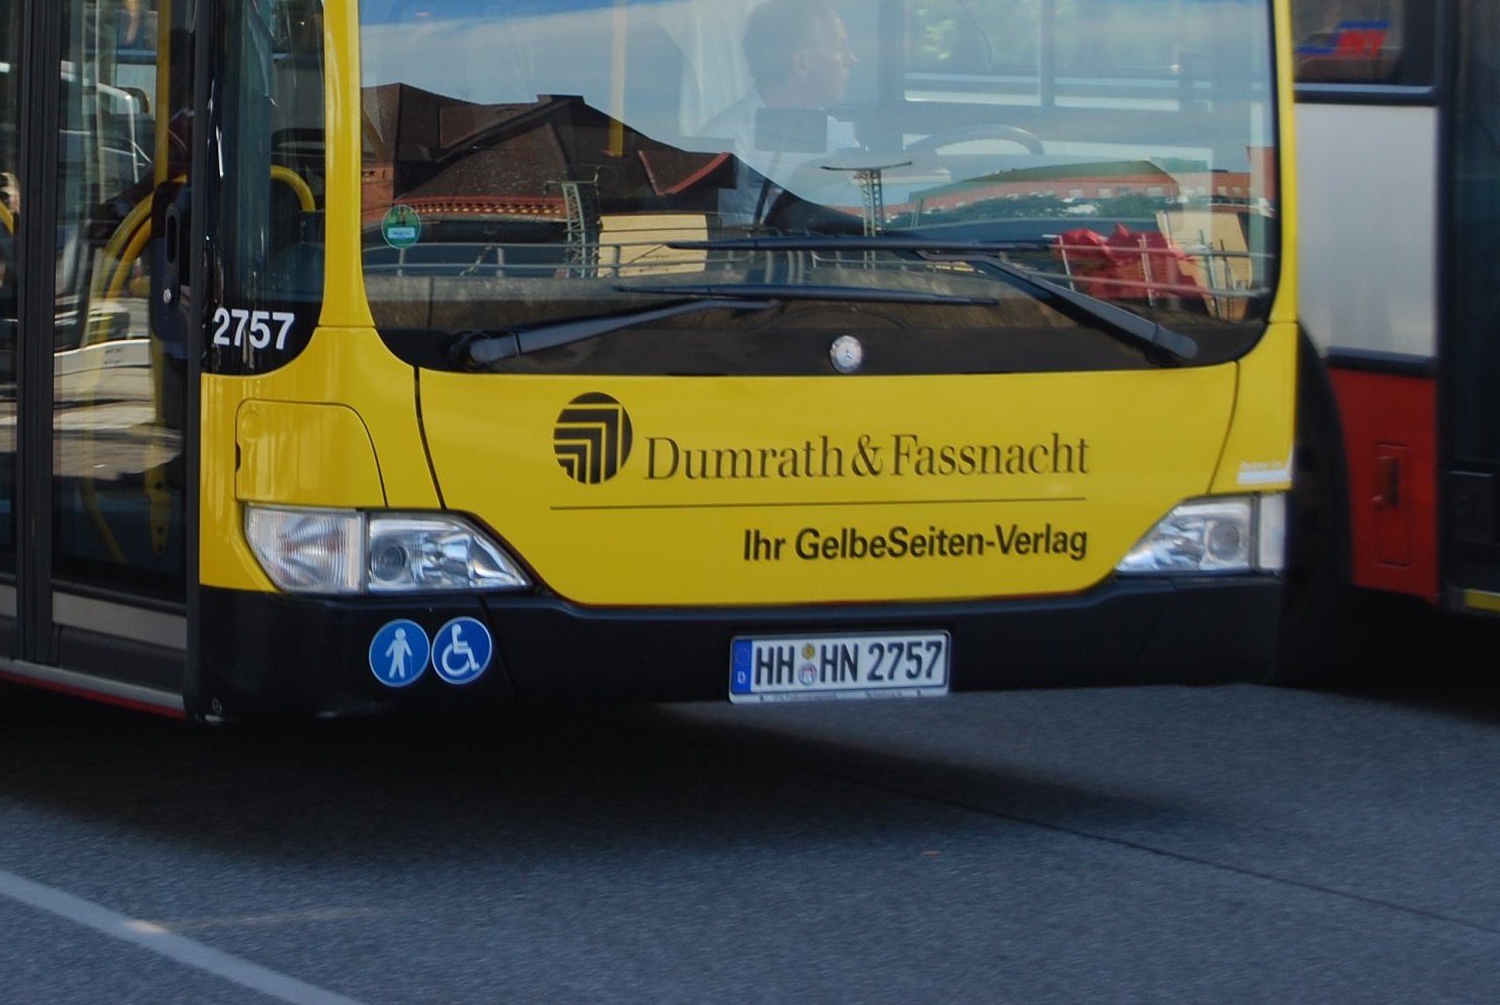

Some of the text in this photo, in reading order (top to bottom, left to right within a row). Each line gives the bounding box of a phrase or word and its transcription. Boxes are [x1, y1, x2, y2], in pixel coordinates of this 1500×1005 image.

[211, 306, 295, 351] 2757
[742, 523, 1089, 563] Ihr GelbeSeiten-Verlag
[754, 640, 944, 686] HH HN 2757
